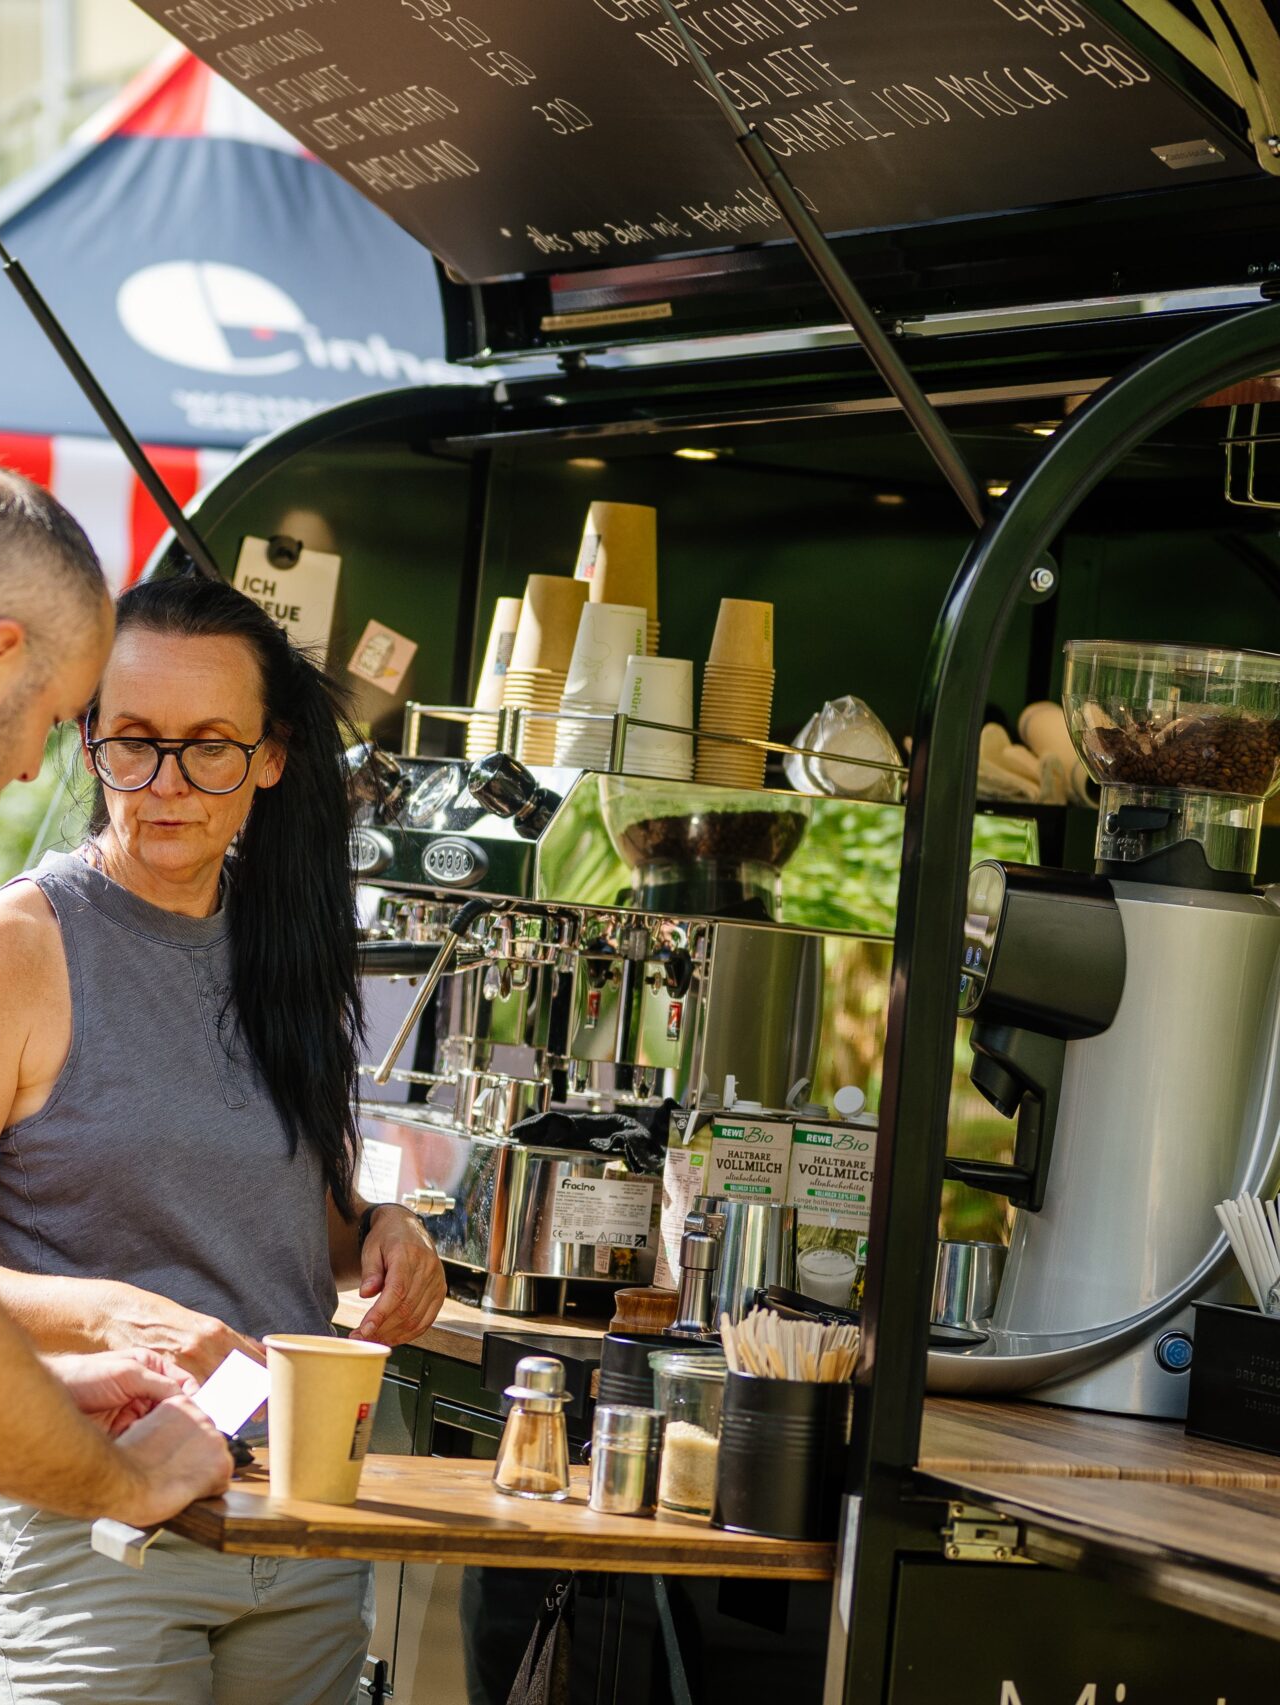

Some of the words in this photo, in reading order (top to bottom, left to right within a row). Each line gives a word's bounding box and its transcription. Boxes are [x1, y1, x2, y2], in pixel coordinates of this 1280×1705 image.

[427, 16, 492, 51] 4.20
[702, 0, 785, 46] CHAI
[469, 50, 537, 87] 4.50
[746, 43, 857, 98] LATTE
[748, 98, 896, 157] CARAMEL
[1059, 41, 1151, 89] 4.90
[346, 138, 480, 195] AMERICANO
[531, 97, 594, 135] 3.20
[242, 575, 277, 597] ICH
[721, 1128, 745, 1138] REWE
[744, 1127, 774, 1144] Bio
[806, 1133, 832, 1145] REWE
[832, 1133, 870, 1152] Bio
[716, 1158, 783, 1174] VOLLMILCH
[727, 1150, 772, 1161] HALTBARE
[813, 1156, 867, 1170] HALTBARE
